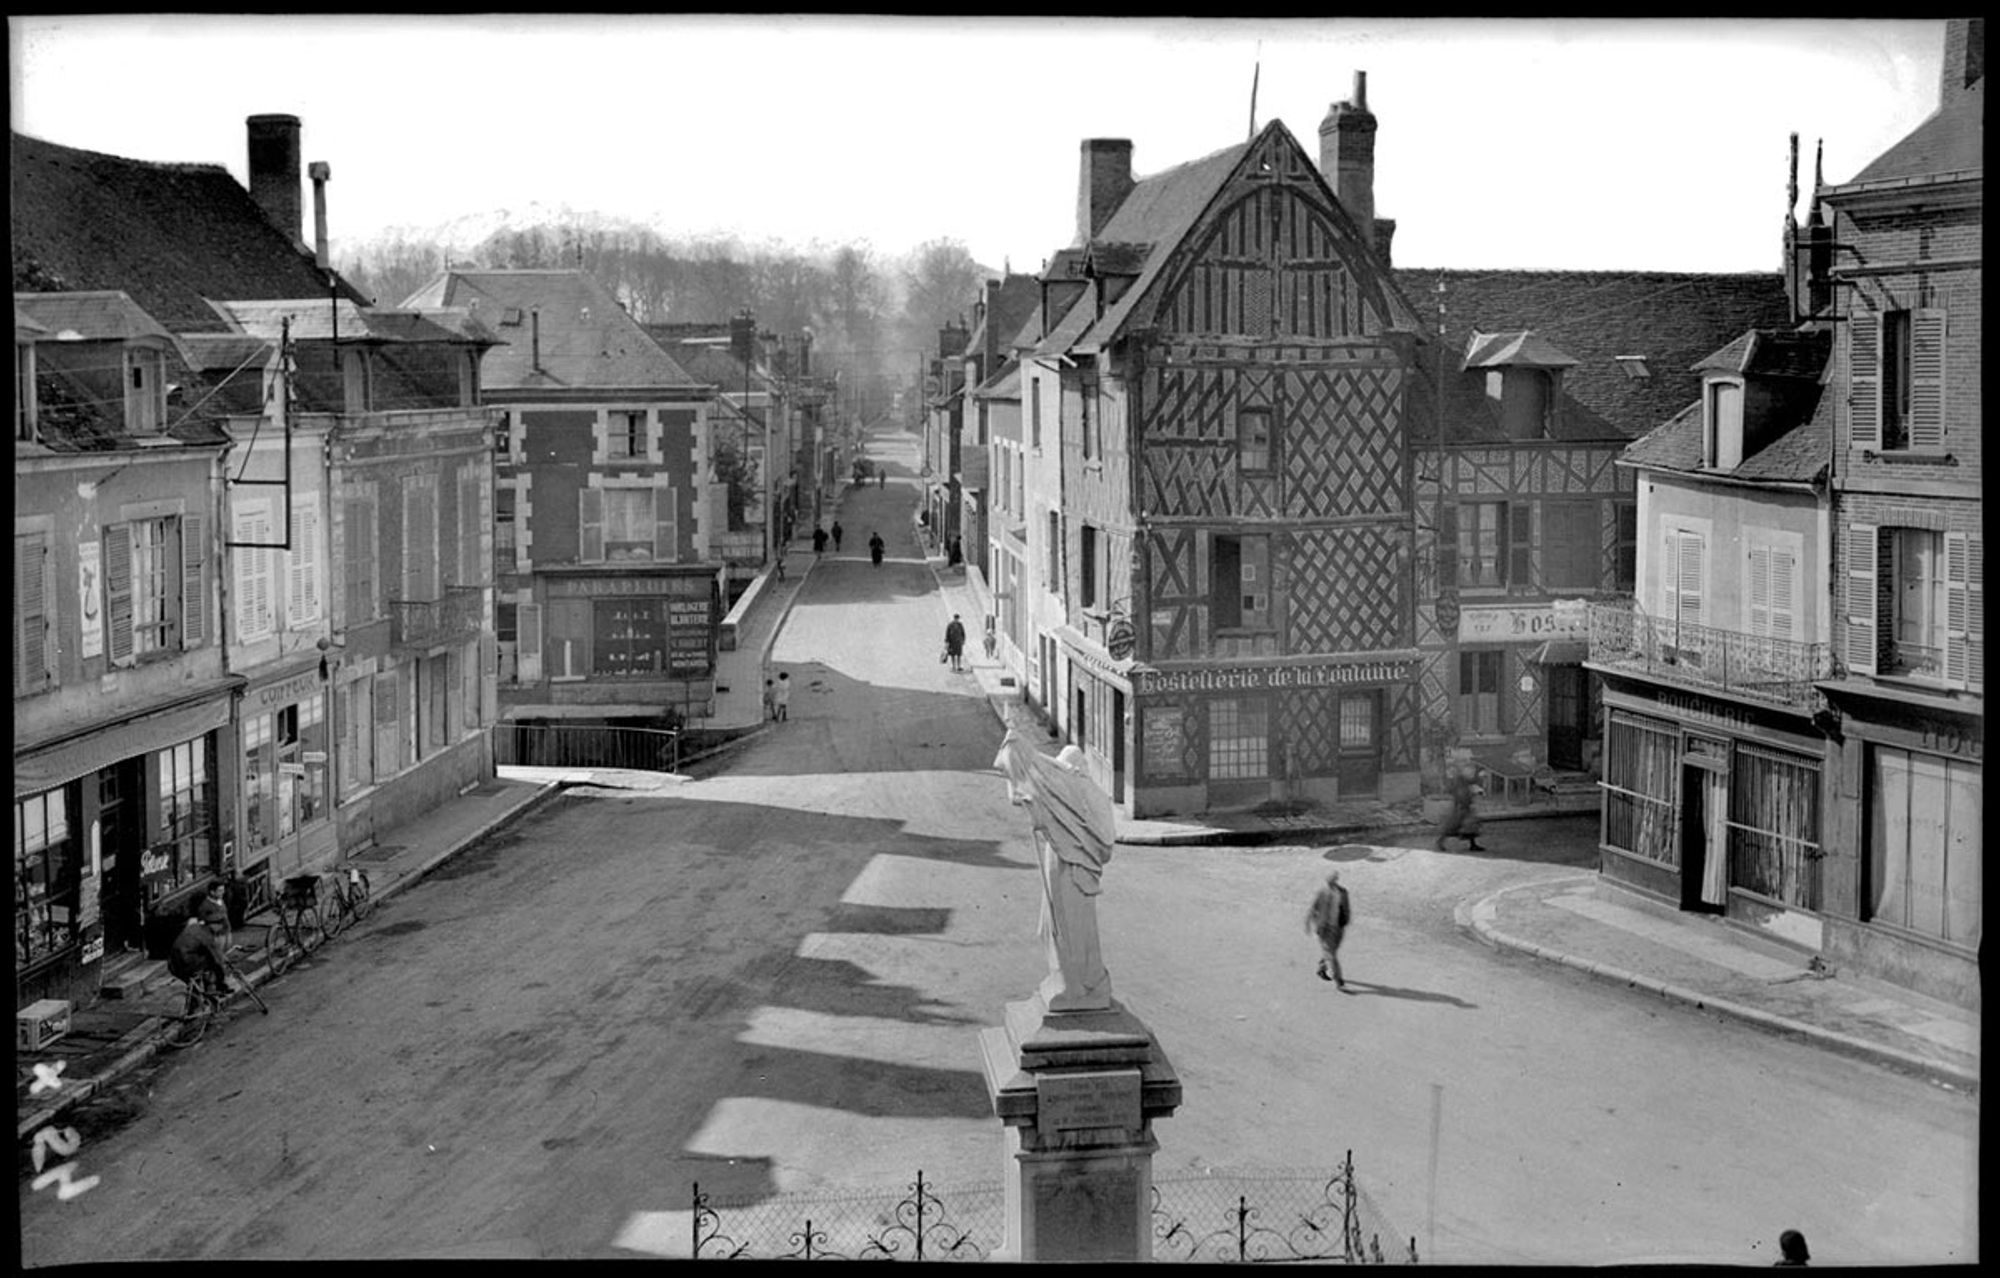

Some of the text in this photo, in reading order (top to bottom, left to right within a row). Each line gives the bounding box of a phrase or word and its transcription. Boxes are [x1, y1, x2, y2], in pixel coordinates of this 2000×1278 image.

[260, 676, 314, 705] COIFFEUR
[1141, 670, 1258, 695] Hostellerie
[1268, 670, 1292, 688] de
[1297, 668, 1312, 685] la
[1657, 690, 1755, 732] BOUCHERIE
